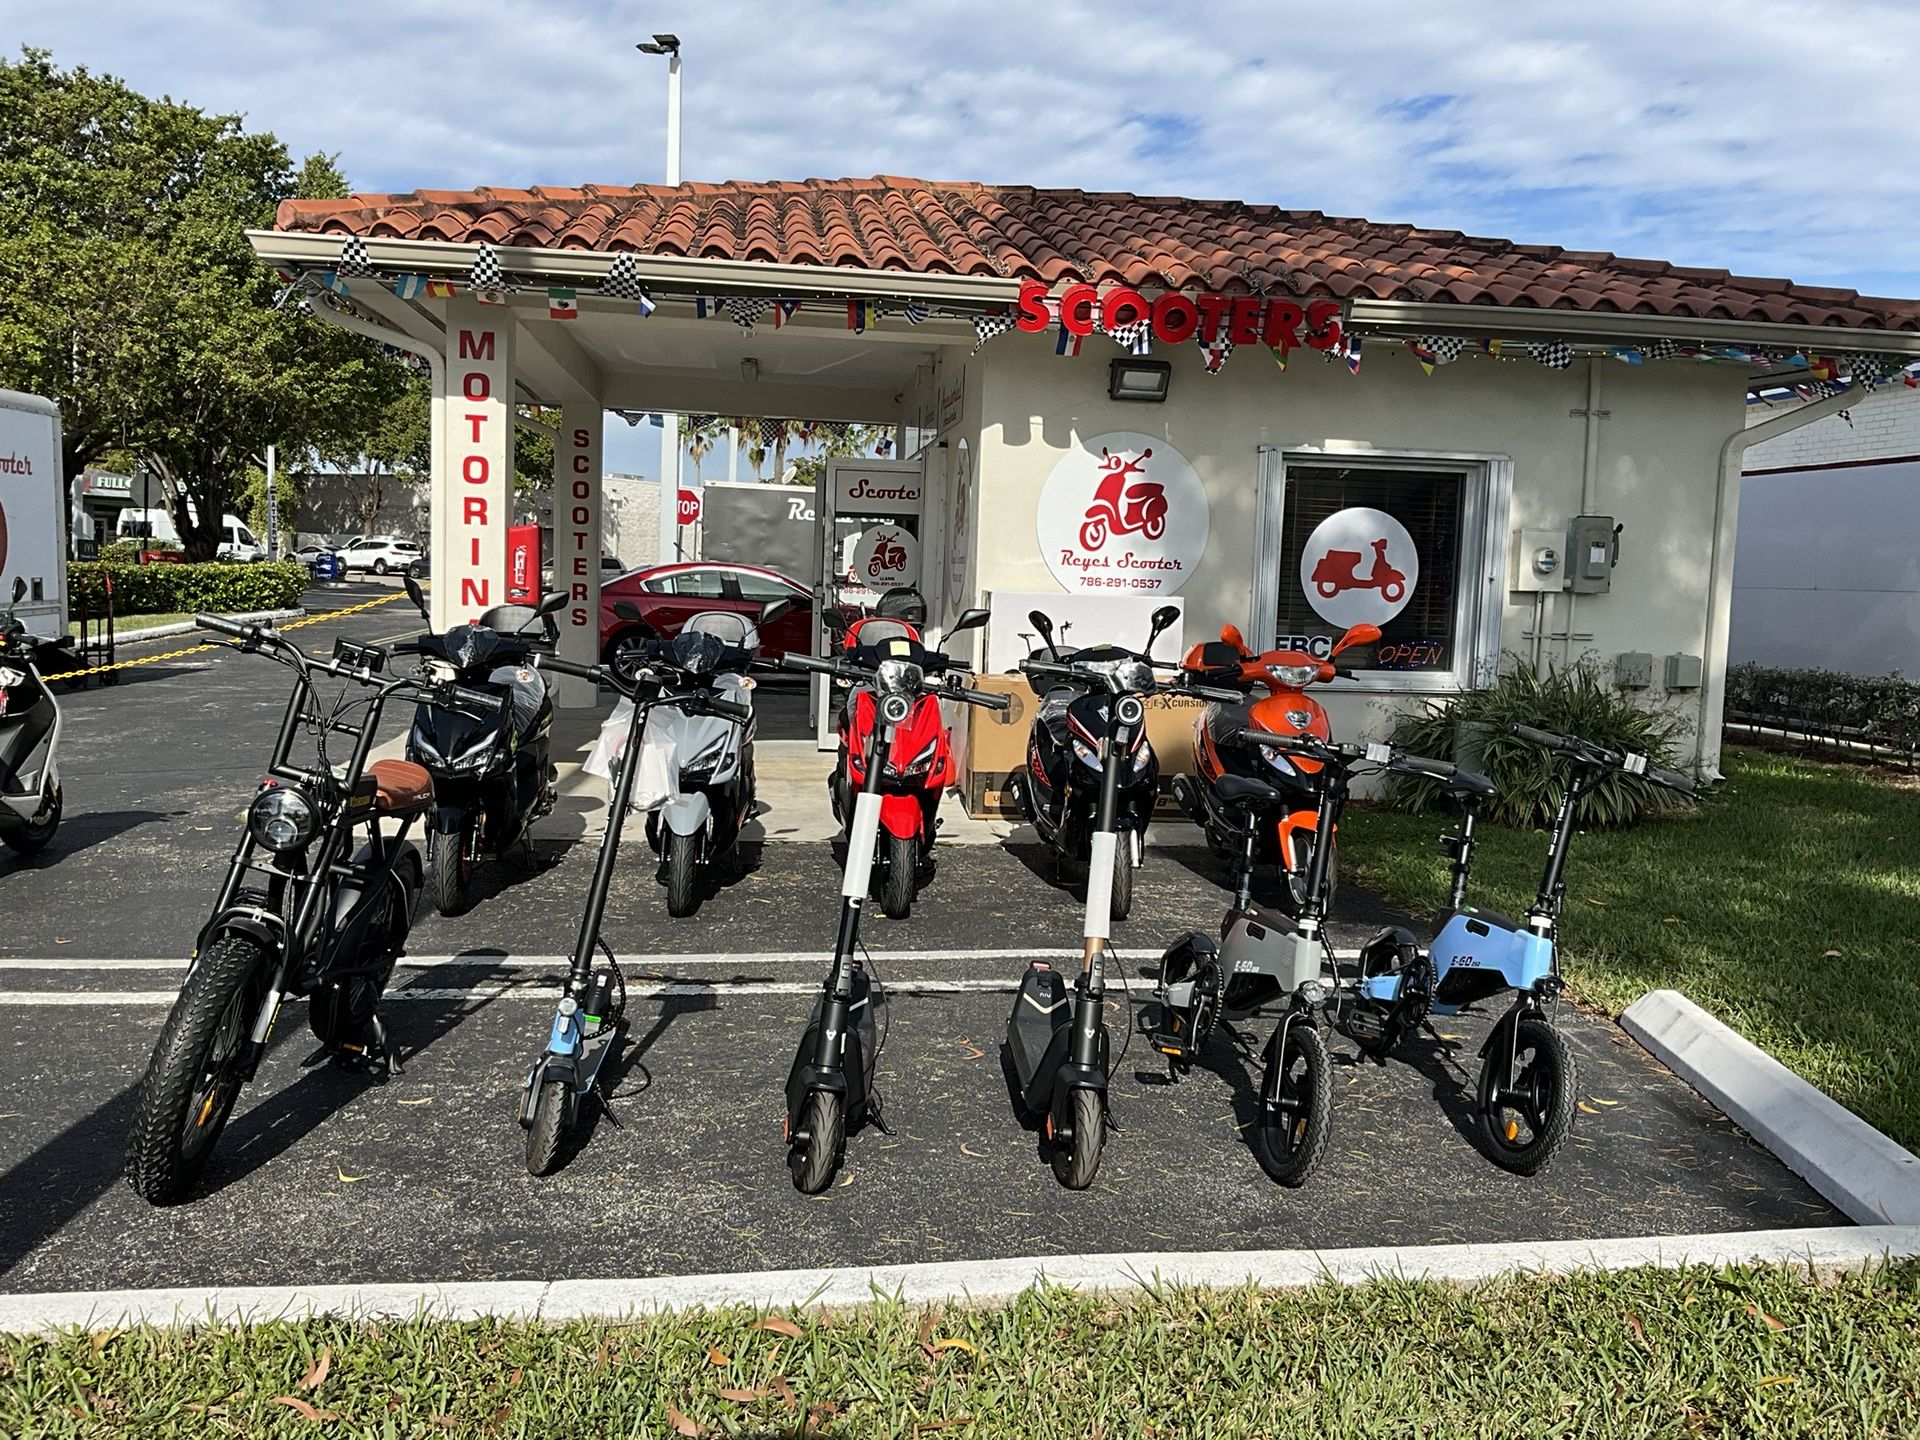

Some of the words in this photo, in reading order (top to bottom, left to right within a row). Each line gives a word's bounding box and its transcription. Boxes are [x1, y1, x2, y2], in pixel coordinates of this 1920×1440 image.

[1015, 279, 1341, 350] SCOOTERS
[0, 450, 33, 475] oter
[459, 330, 495, 625] MOTORIN
[678, 500, 699, 515] TOP
[572, 428, 590, 626] SCOOTERS
[1061, 549, 1110, 571] Reyes
[1117, 552, 1182, 570] Scooter
[1080, 577, 1162, 589] 786-291-0537
[1378, 645, 1444, 665] OPEN
